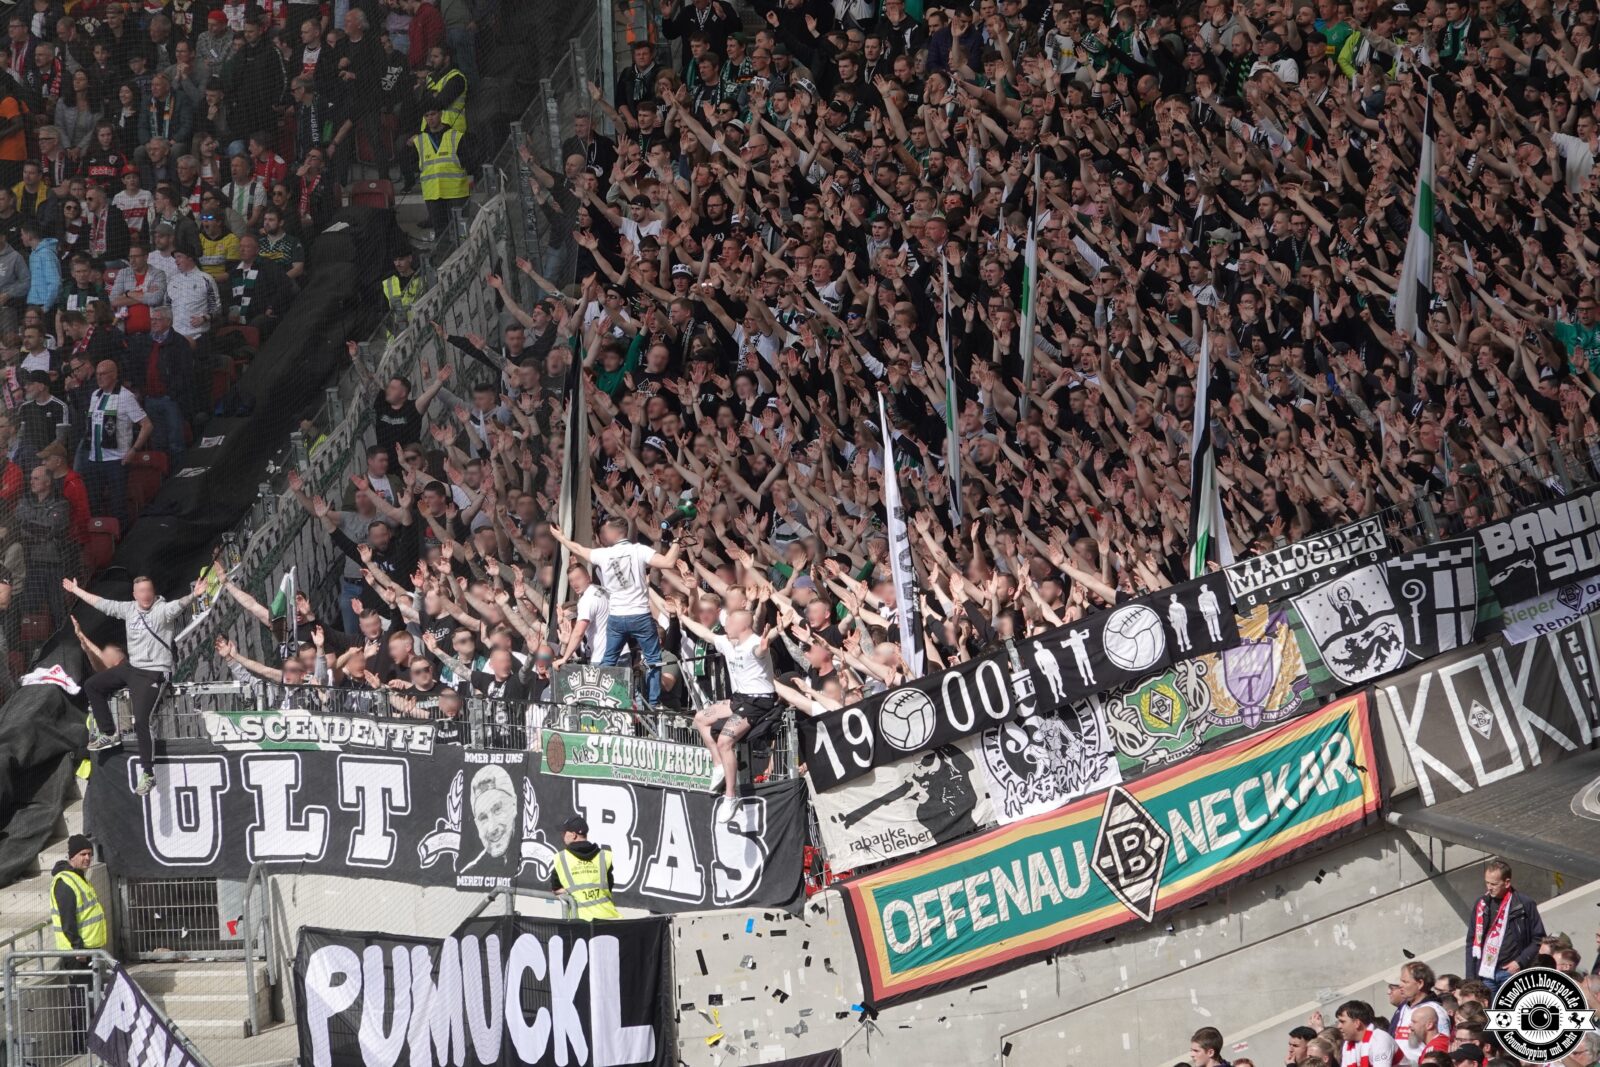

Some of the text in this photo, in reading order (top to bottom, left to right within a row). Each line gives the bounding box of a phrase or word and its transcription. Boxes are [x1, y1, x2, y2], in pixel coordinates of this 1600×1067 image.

[1225, 520, 1382, 595] MALOCHER
[1247, 566, 1337, 606] gruppe
[1502, 598, 1556, 627] Sieper
[578, 689, 602, 699] NORD
[209, 712, 435, 756] ASCENDENTE
[490, 753, 504, 764] BEI
[505, 753, 524, 764] UNS
[1003, 748, 1110, 818] ACKERBANDE
[849, 827, 906, 853] rabauke
[881, 840, 1092, 956] OFFENAU
[1167, 731, 1357, 866] NECKAR
[484, 876, 496, 887] CU
[304, 933, 656, 1067] PUMUCKL
